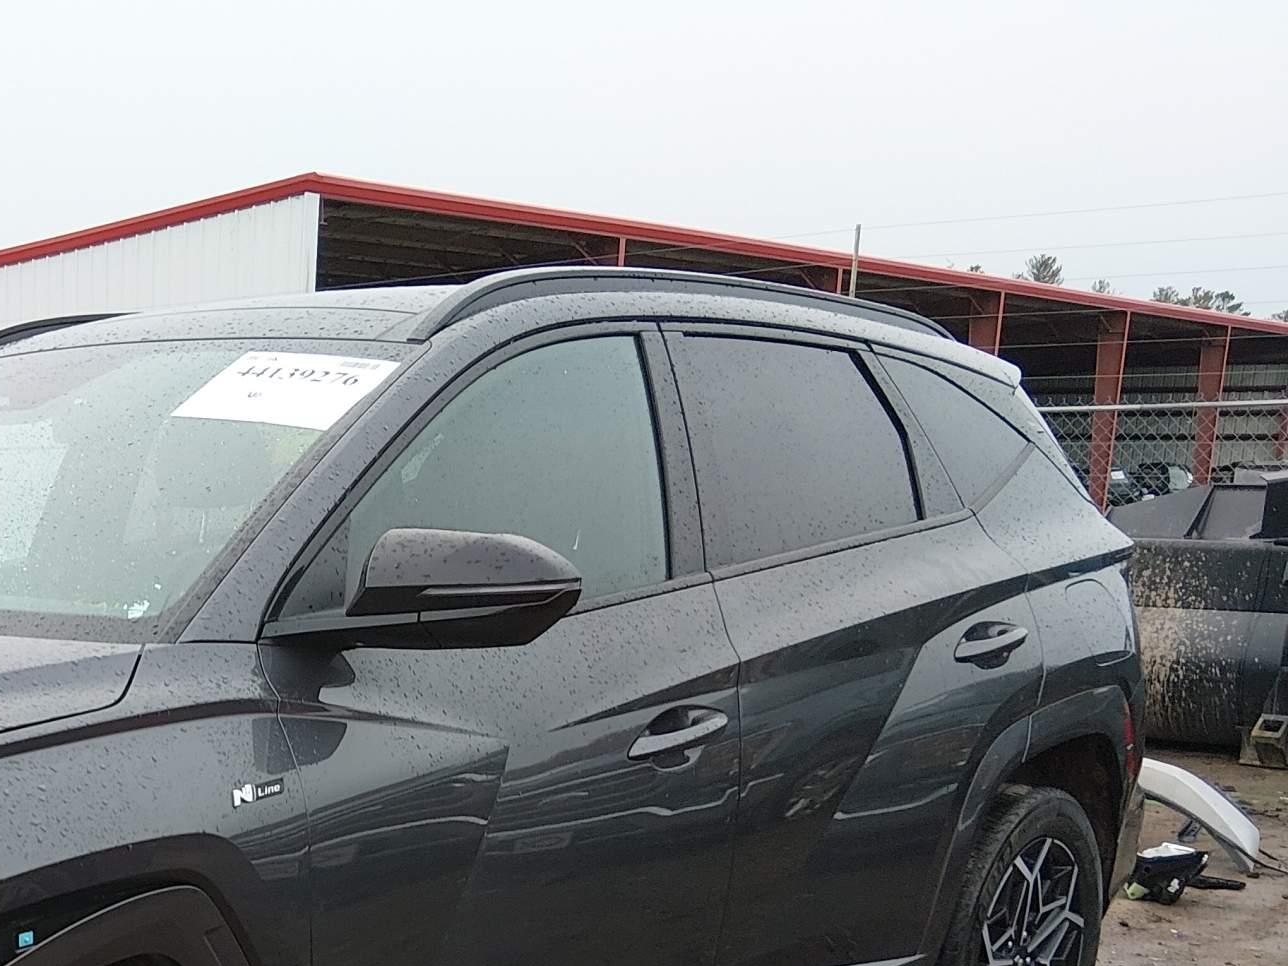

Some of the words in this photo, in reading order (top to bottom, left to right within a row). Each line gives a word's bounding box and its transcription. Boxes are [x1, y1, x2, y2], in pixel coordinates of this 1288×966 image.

[238, 365, 359, 386] 44139276
[233, 784, 253, 806] N
[257, 784, 280, 797] Line
